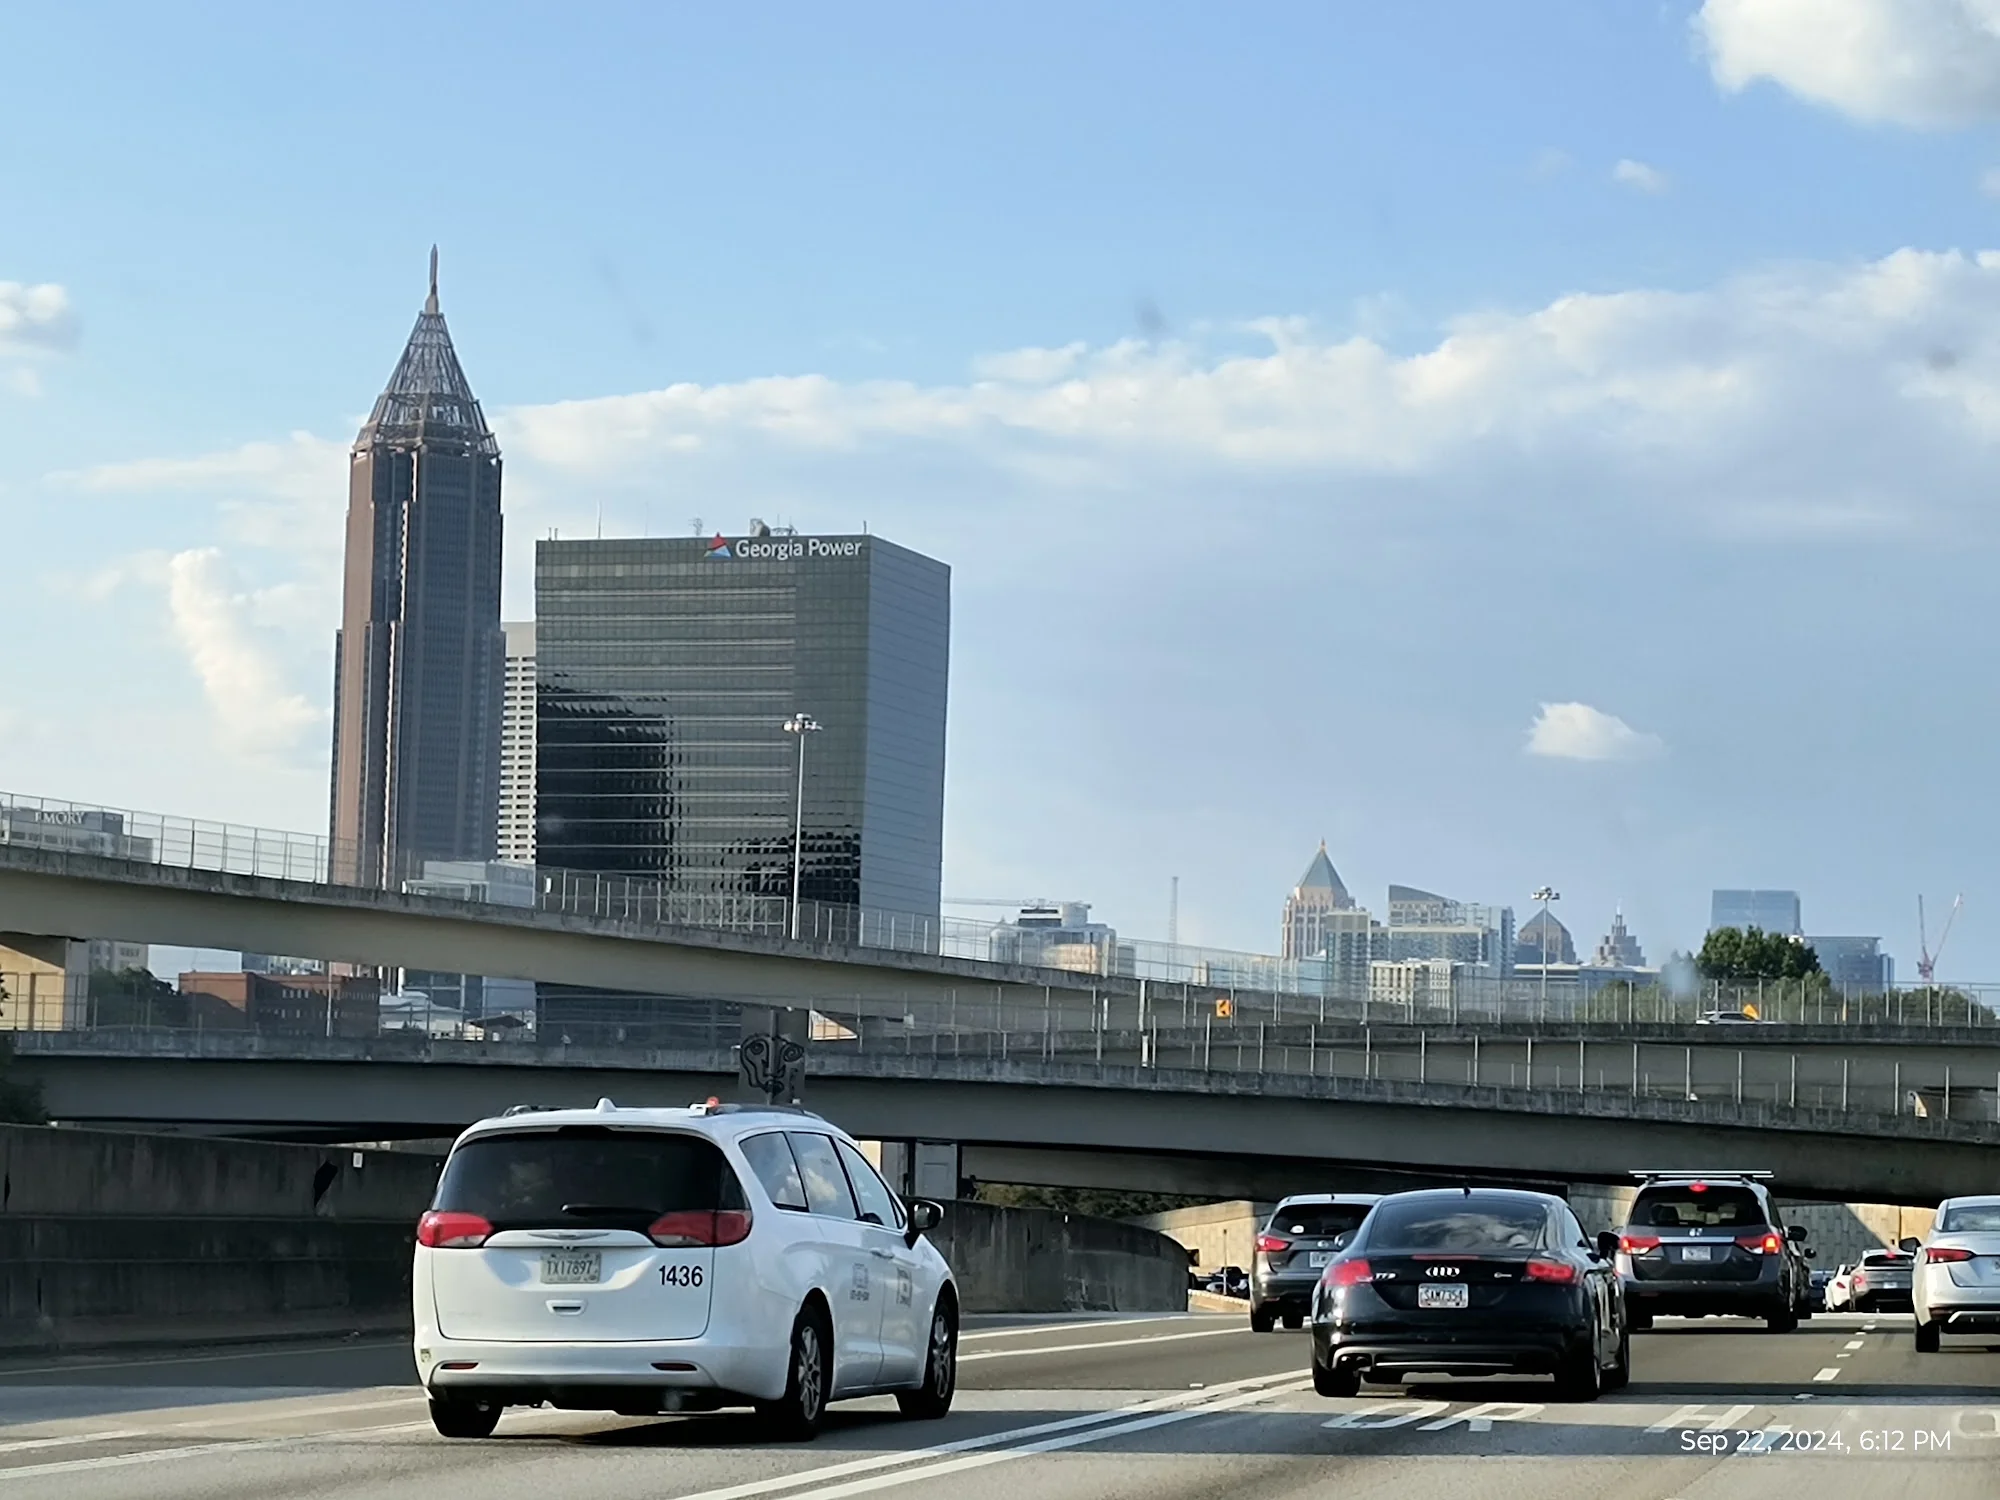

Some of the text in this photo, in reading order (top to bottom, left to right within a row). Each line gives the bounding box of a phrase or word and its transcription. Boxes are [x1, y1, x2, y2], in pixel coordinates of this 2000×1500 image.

[736, 538, 862, 560] Georgia Power
[658, 1265, 703, 1288] 1436
